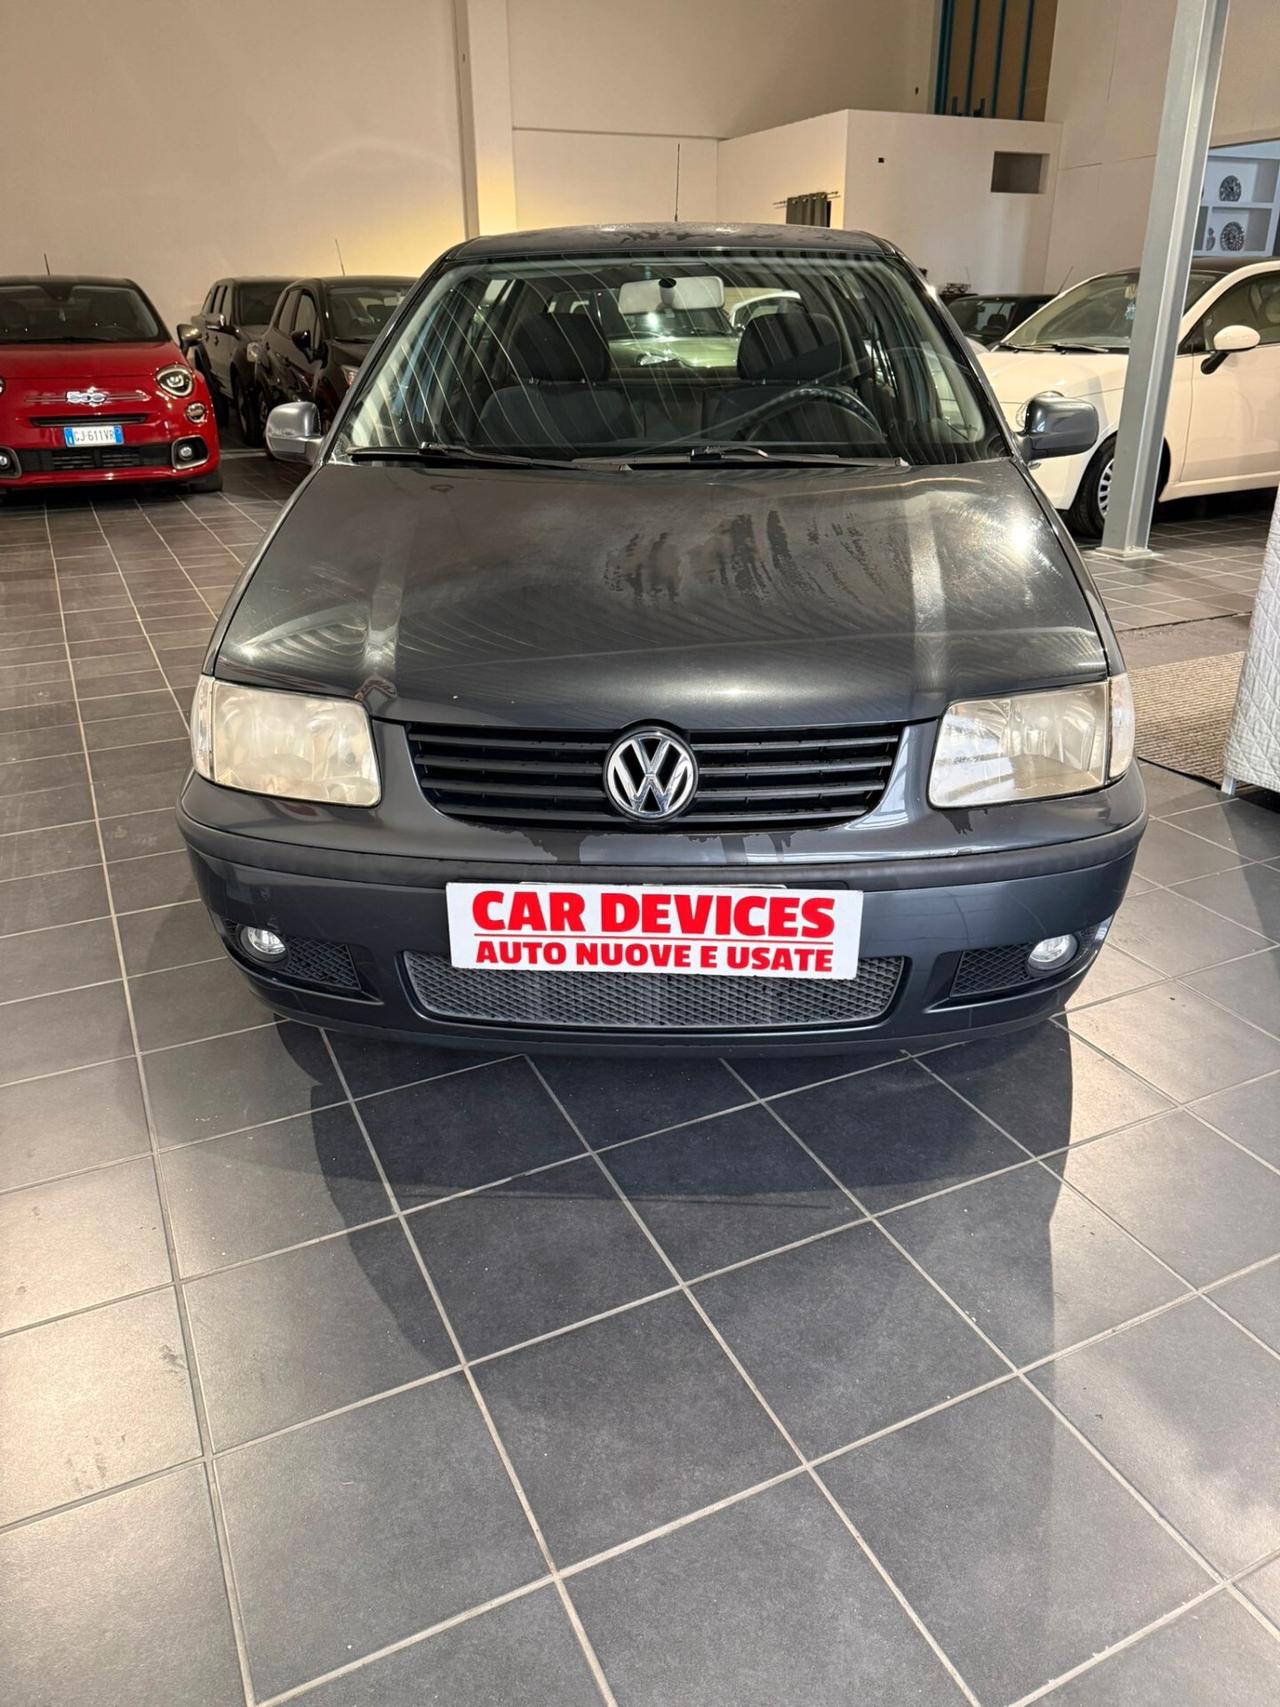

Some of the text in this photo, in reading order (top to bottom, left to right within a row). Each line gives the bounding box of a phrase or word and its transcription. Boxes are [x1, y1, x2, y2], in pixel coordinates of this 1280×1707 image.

[607, 731, 694, 818] VW
[472, 890, 835, 939] CAR DEVICES
[476, 941, 833, 972] AUTO NUOVE E USATE
